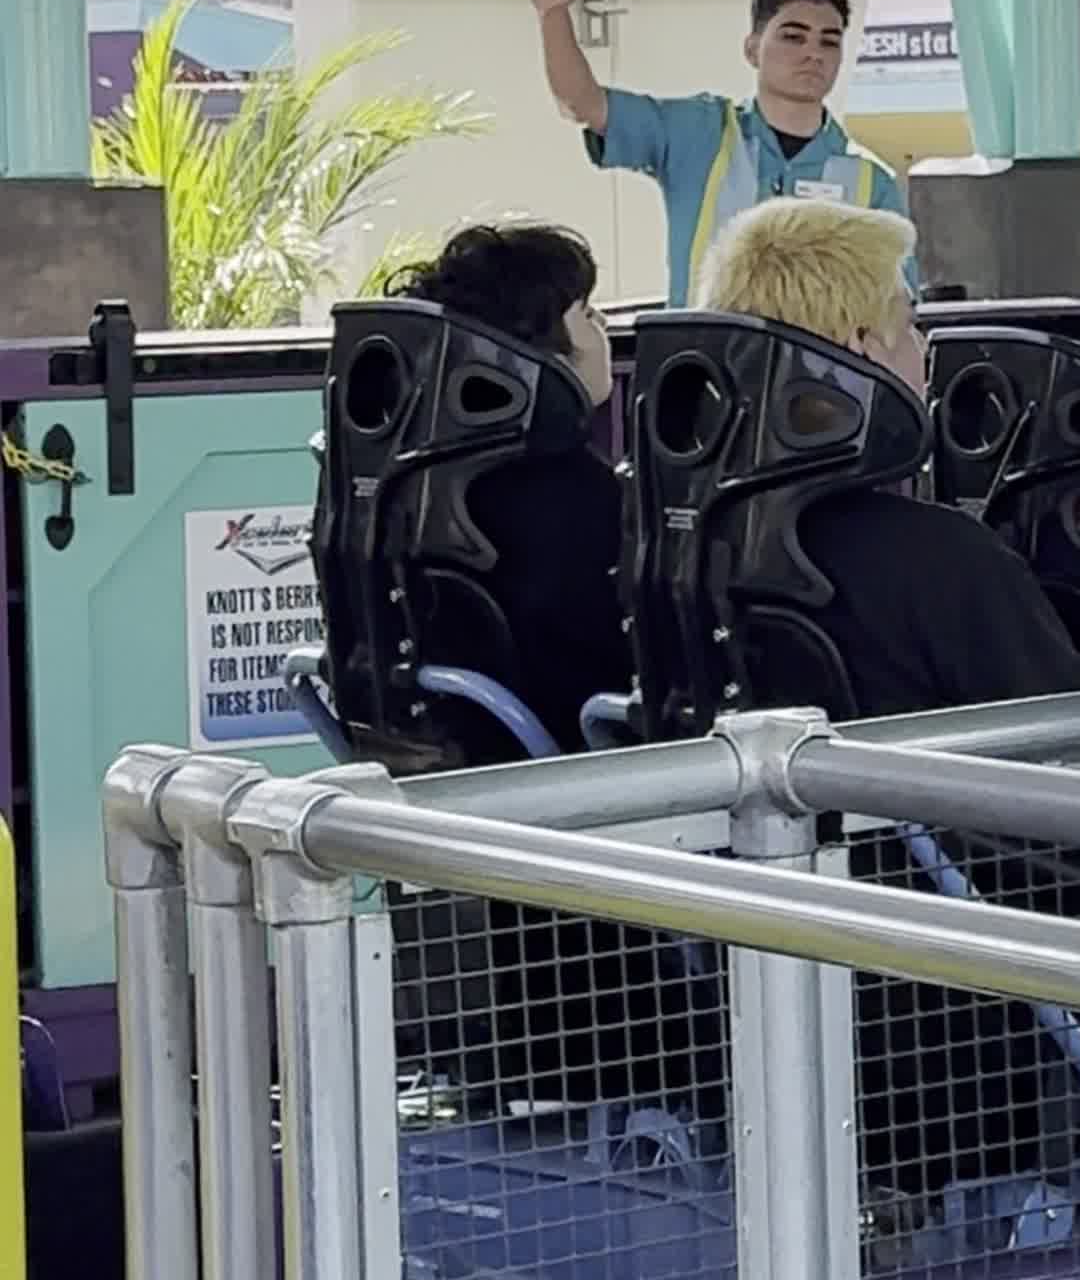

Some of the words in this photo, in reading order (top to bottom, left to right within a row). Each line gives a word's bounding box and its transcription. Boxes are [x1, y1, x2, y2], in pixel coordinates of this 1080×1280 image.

[206, 586, 271, 614] KNOTT'S
[211, 624, 227, 648] IS
[231, 621, 261, 647] NOT
[209, 657, 238, 682] FOR
[206, 690, 253, 718] THESE
